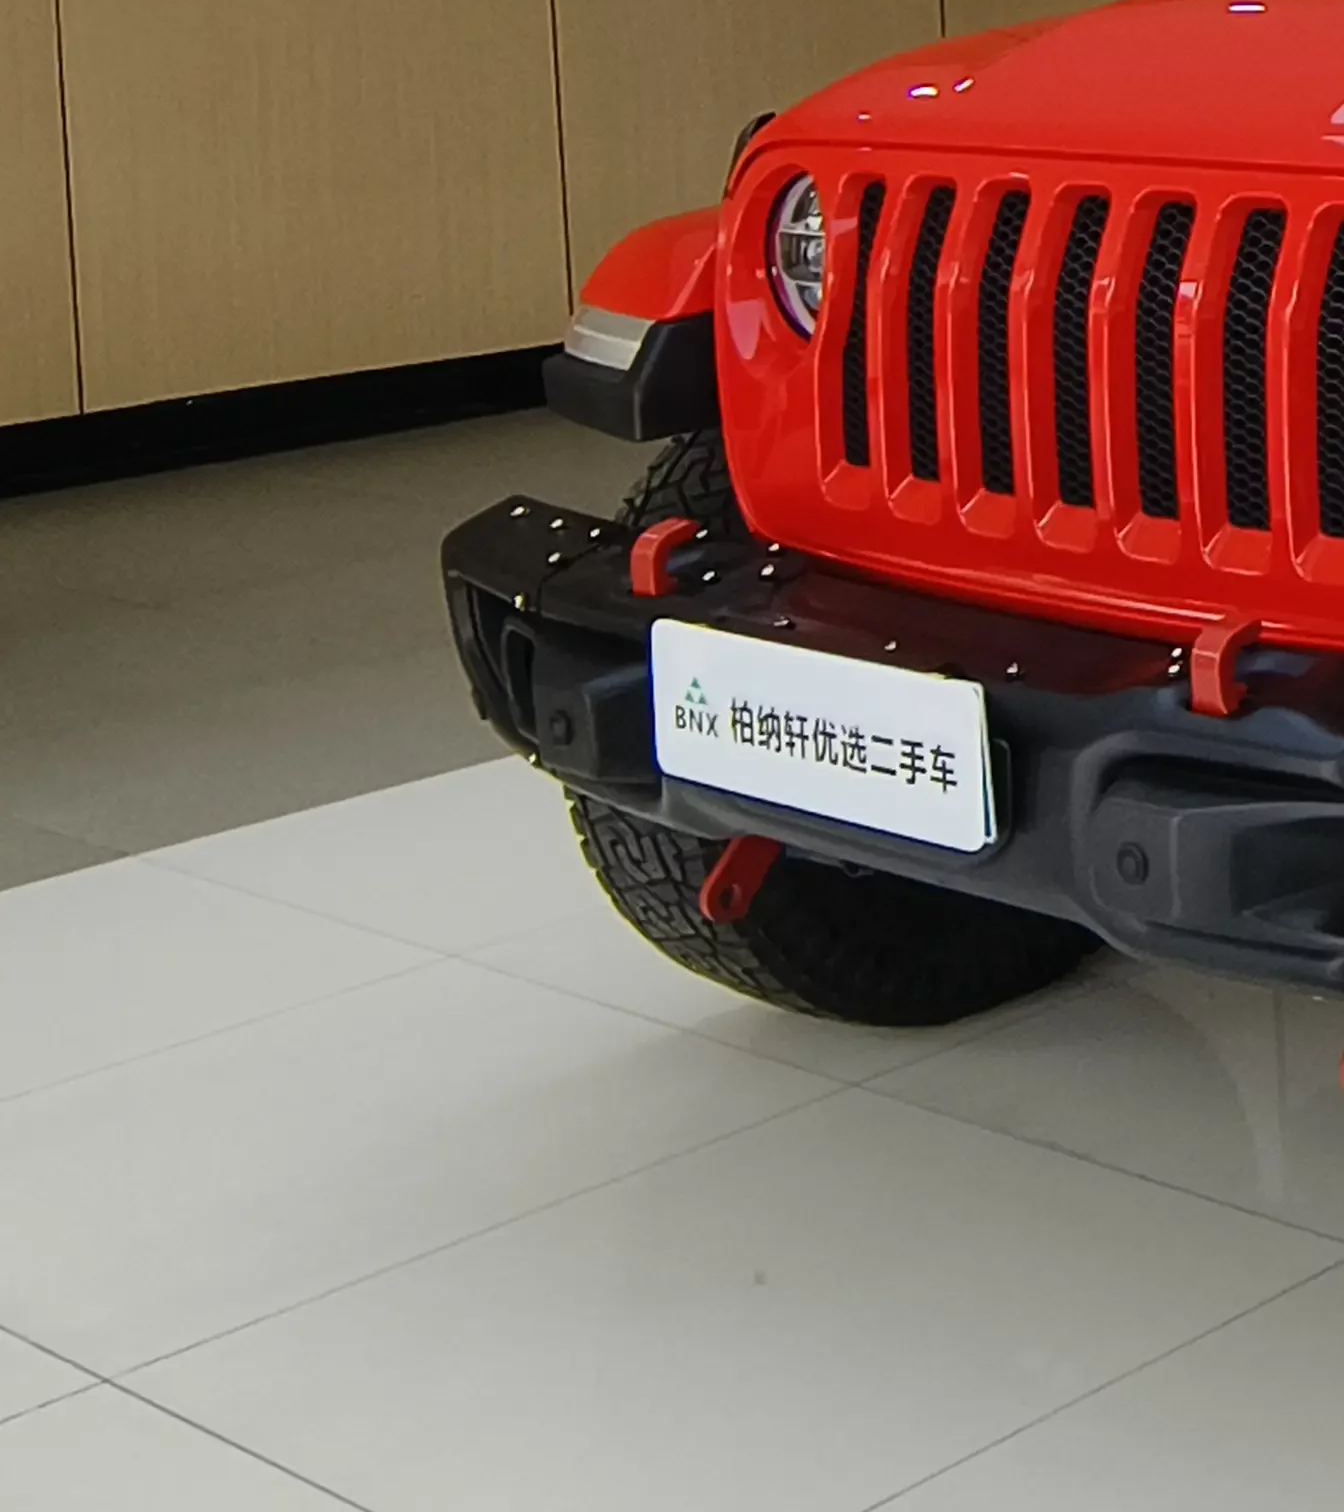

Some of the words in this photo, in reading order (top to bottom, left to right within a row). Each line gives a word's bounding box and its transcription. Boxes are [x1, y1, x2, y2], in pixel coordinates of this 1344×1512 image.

[674, 704, 719, 738] BNX
[730, 697, 958, 793] 柏纳轩优选二手车
